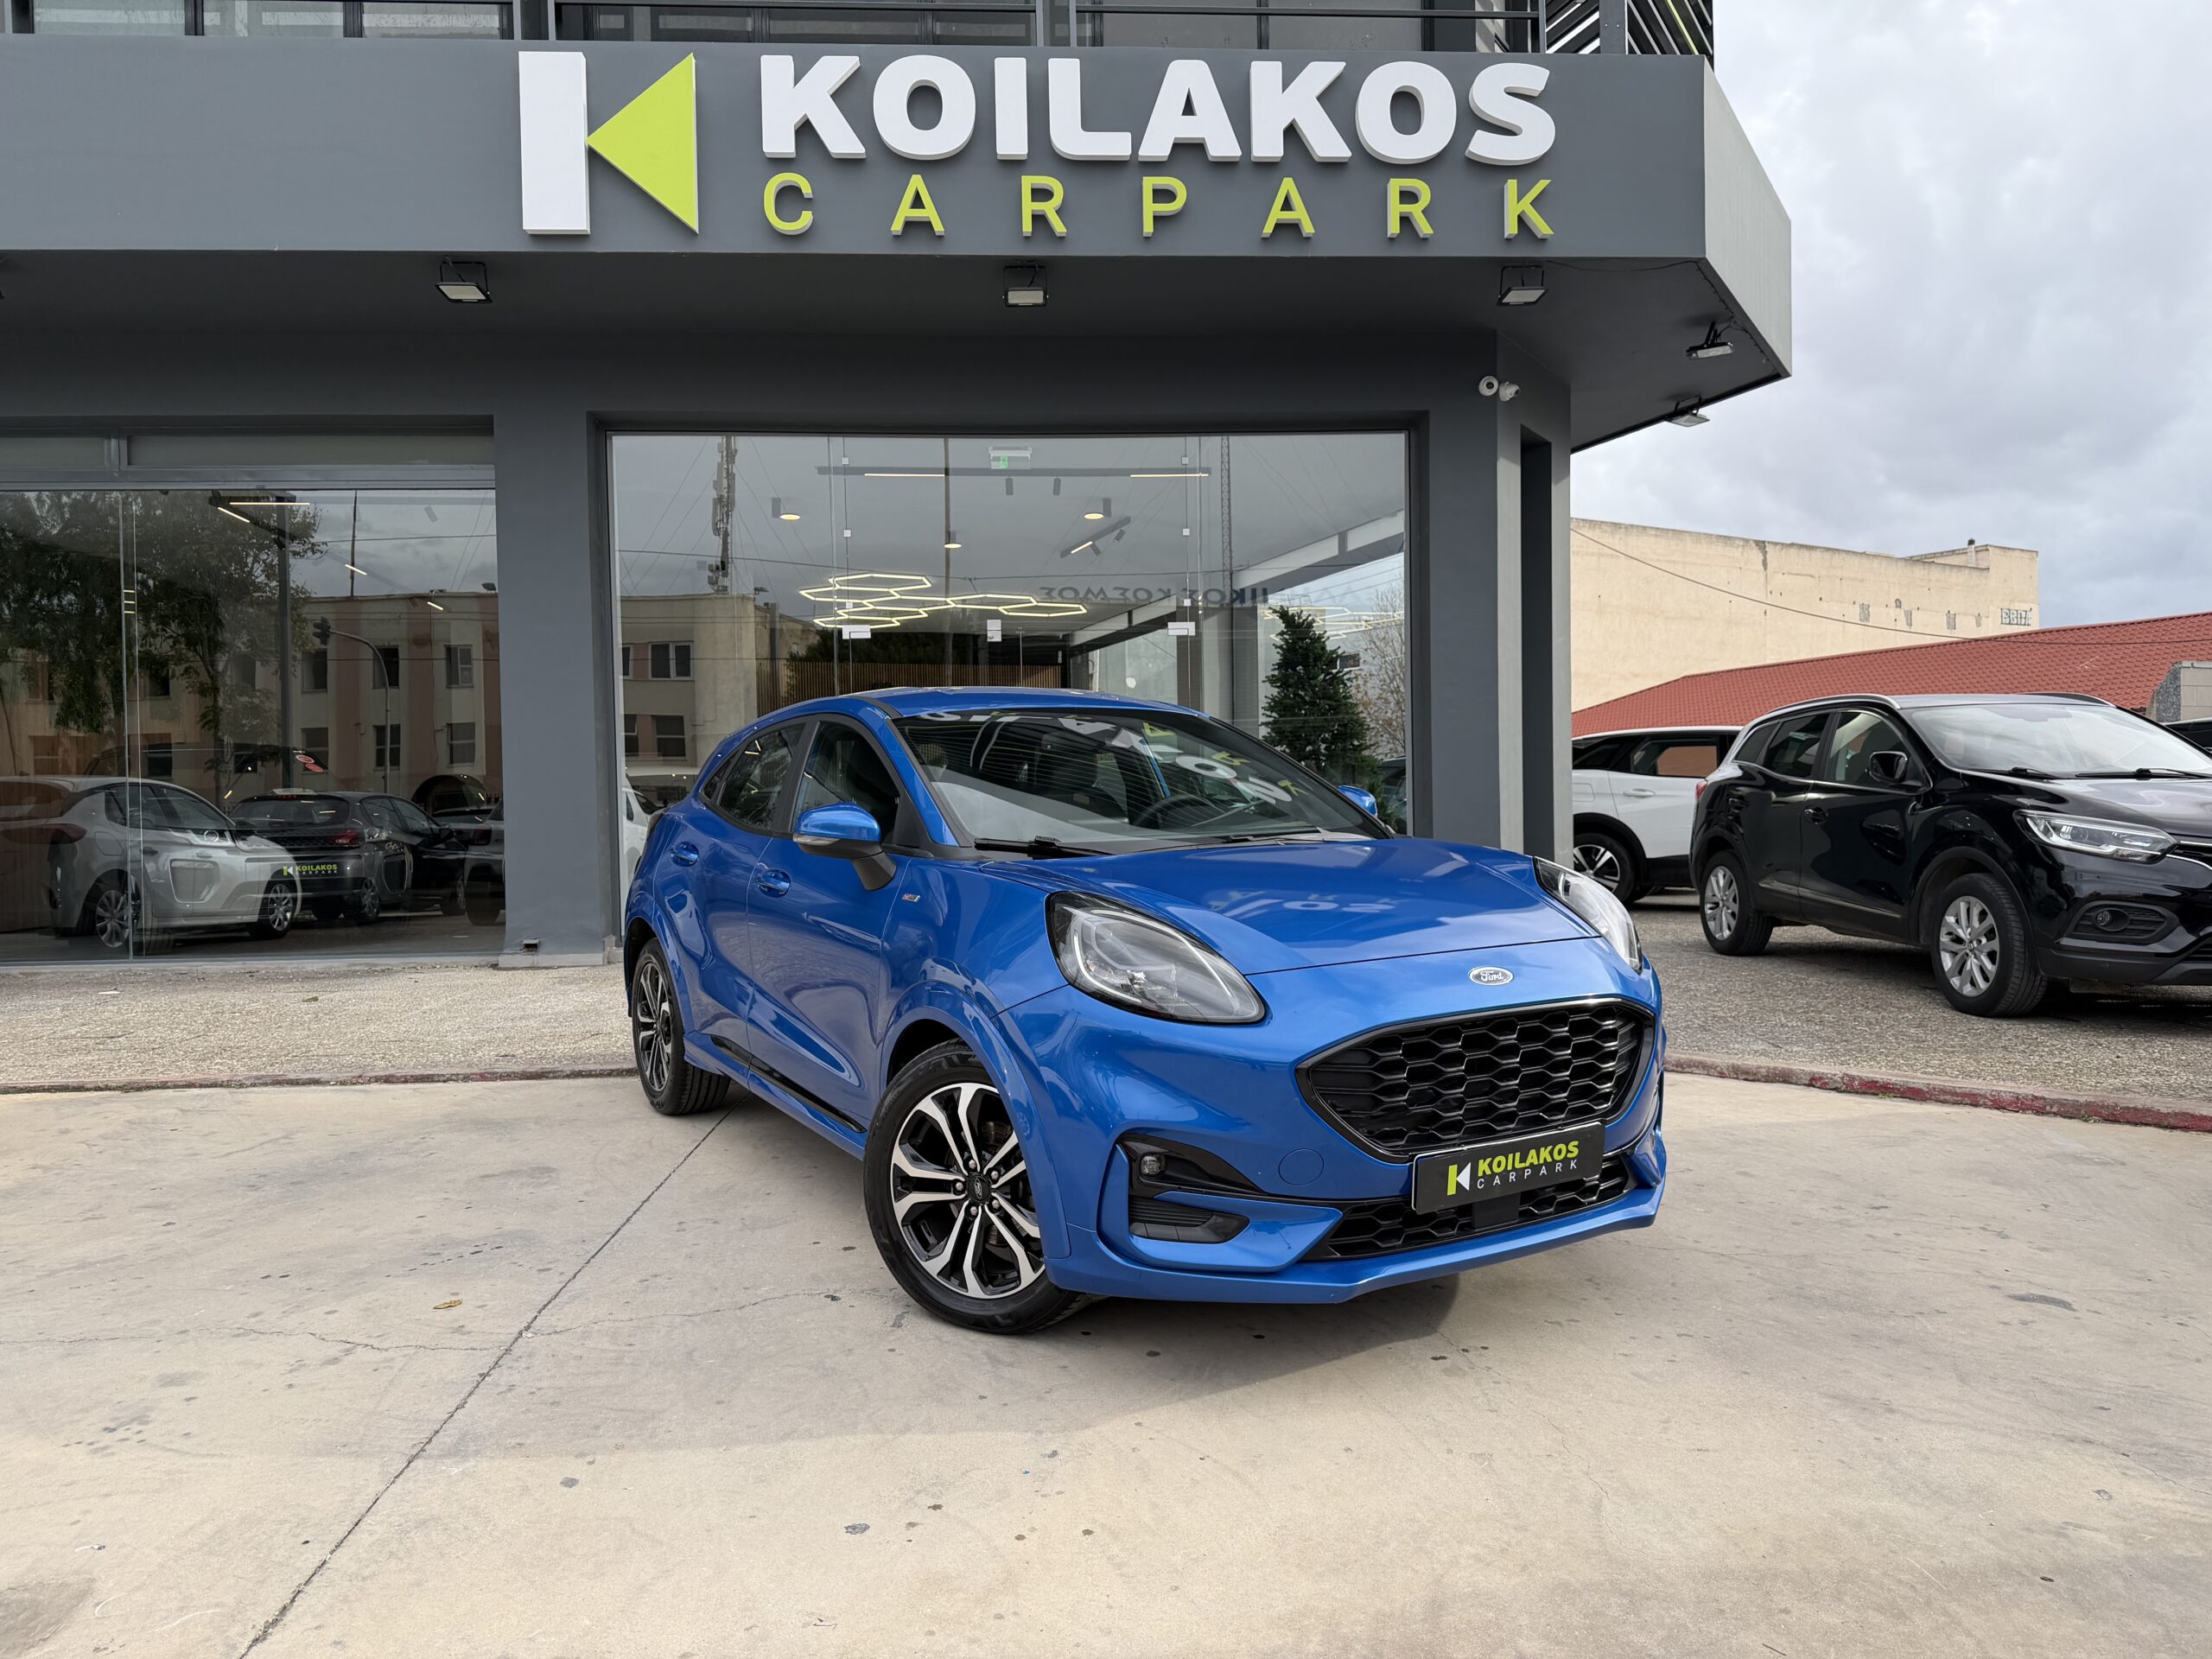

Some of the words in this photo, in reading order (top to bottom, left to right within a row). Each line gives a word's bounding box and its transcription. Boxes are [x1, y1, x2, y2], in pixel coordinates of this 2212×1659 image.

[760, 54, 1555, 165] KOILAKOS
[764, 173, 1554, 238] CARPARK
[1477, 1159, 1578, 1189] CARPARK
[1478, 1140, 1580, 1176] KOILAKOS
